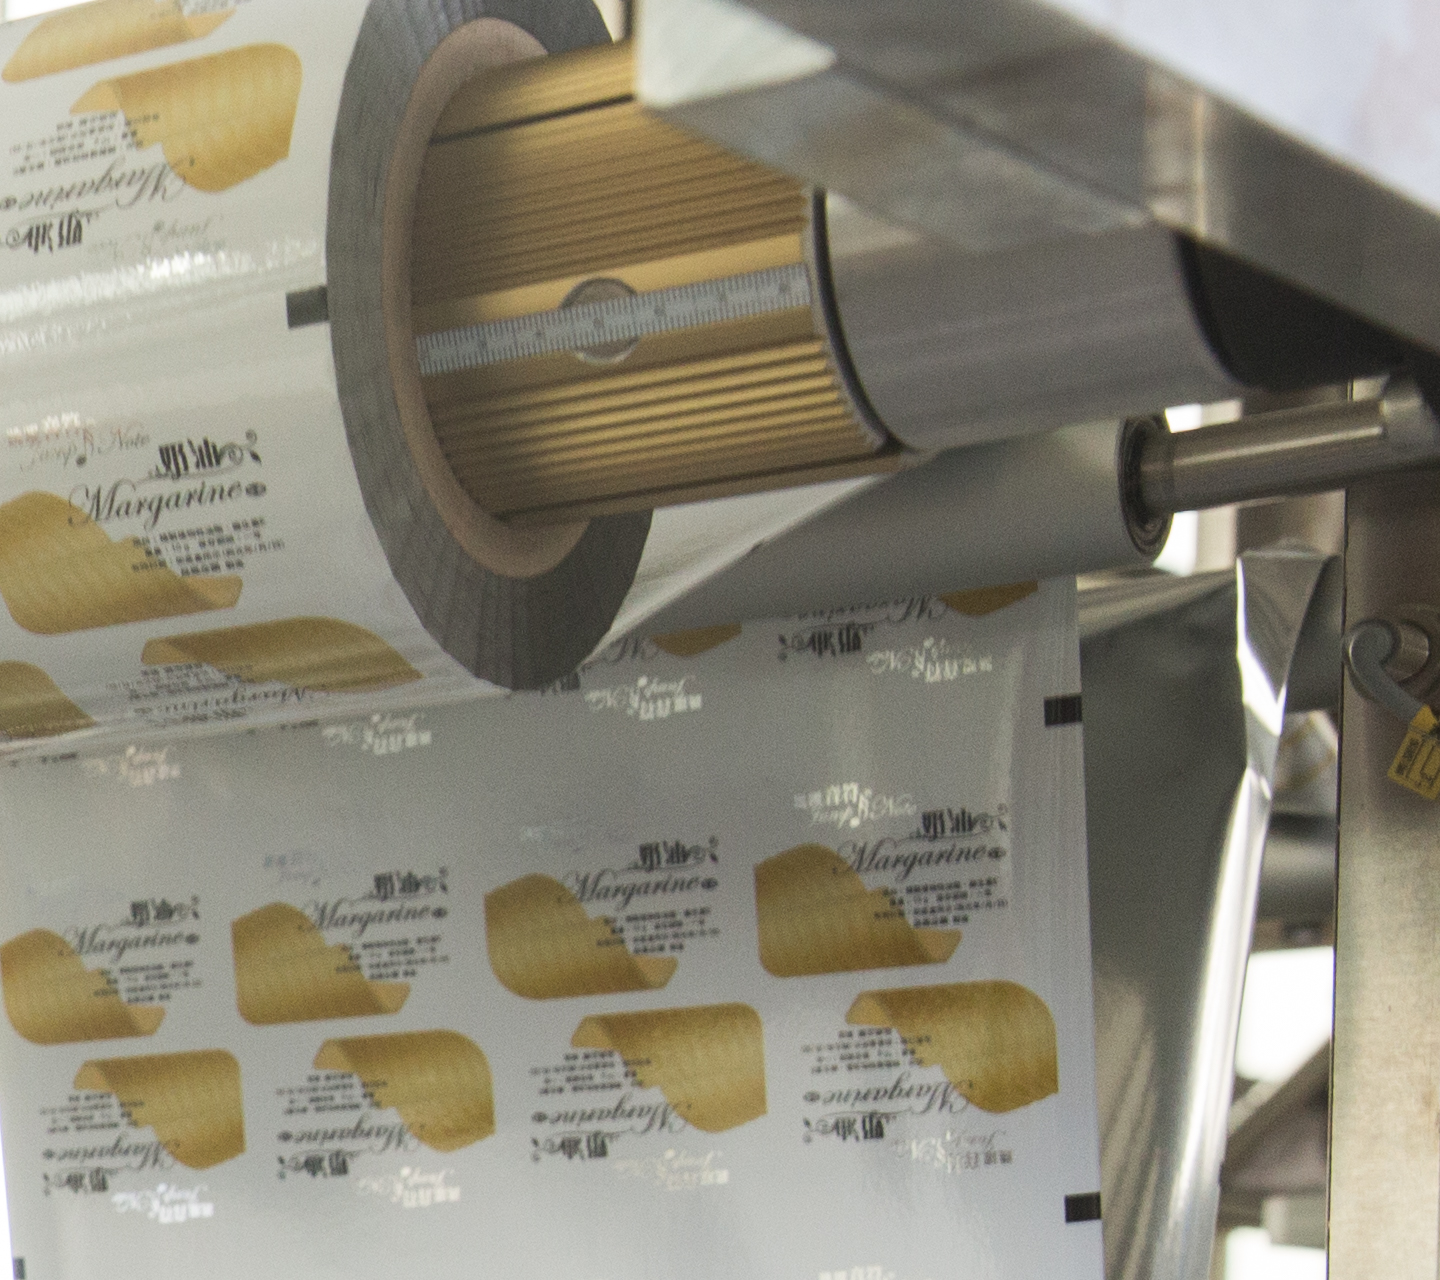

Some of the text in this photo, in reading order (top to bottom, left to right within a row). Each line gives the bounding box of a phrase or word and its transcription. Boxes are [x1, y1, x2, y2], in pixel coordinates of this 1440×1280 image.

[68, 478, 242, 532] Margarine
[832, 837, 985, 882] Margarine
[557, 869, 699, 912] Margarine
[299, 897, 431, 938] Margarine
[553, 1092, 692, 1135] Margarine
[823, 1071, 973, 1114] Margarine
[58, 1134, 181, 1172] Margarine
[295, 1113, 424, 1153] Margarine
